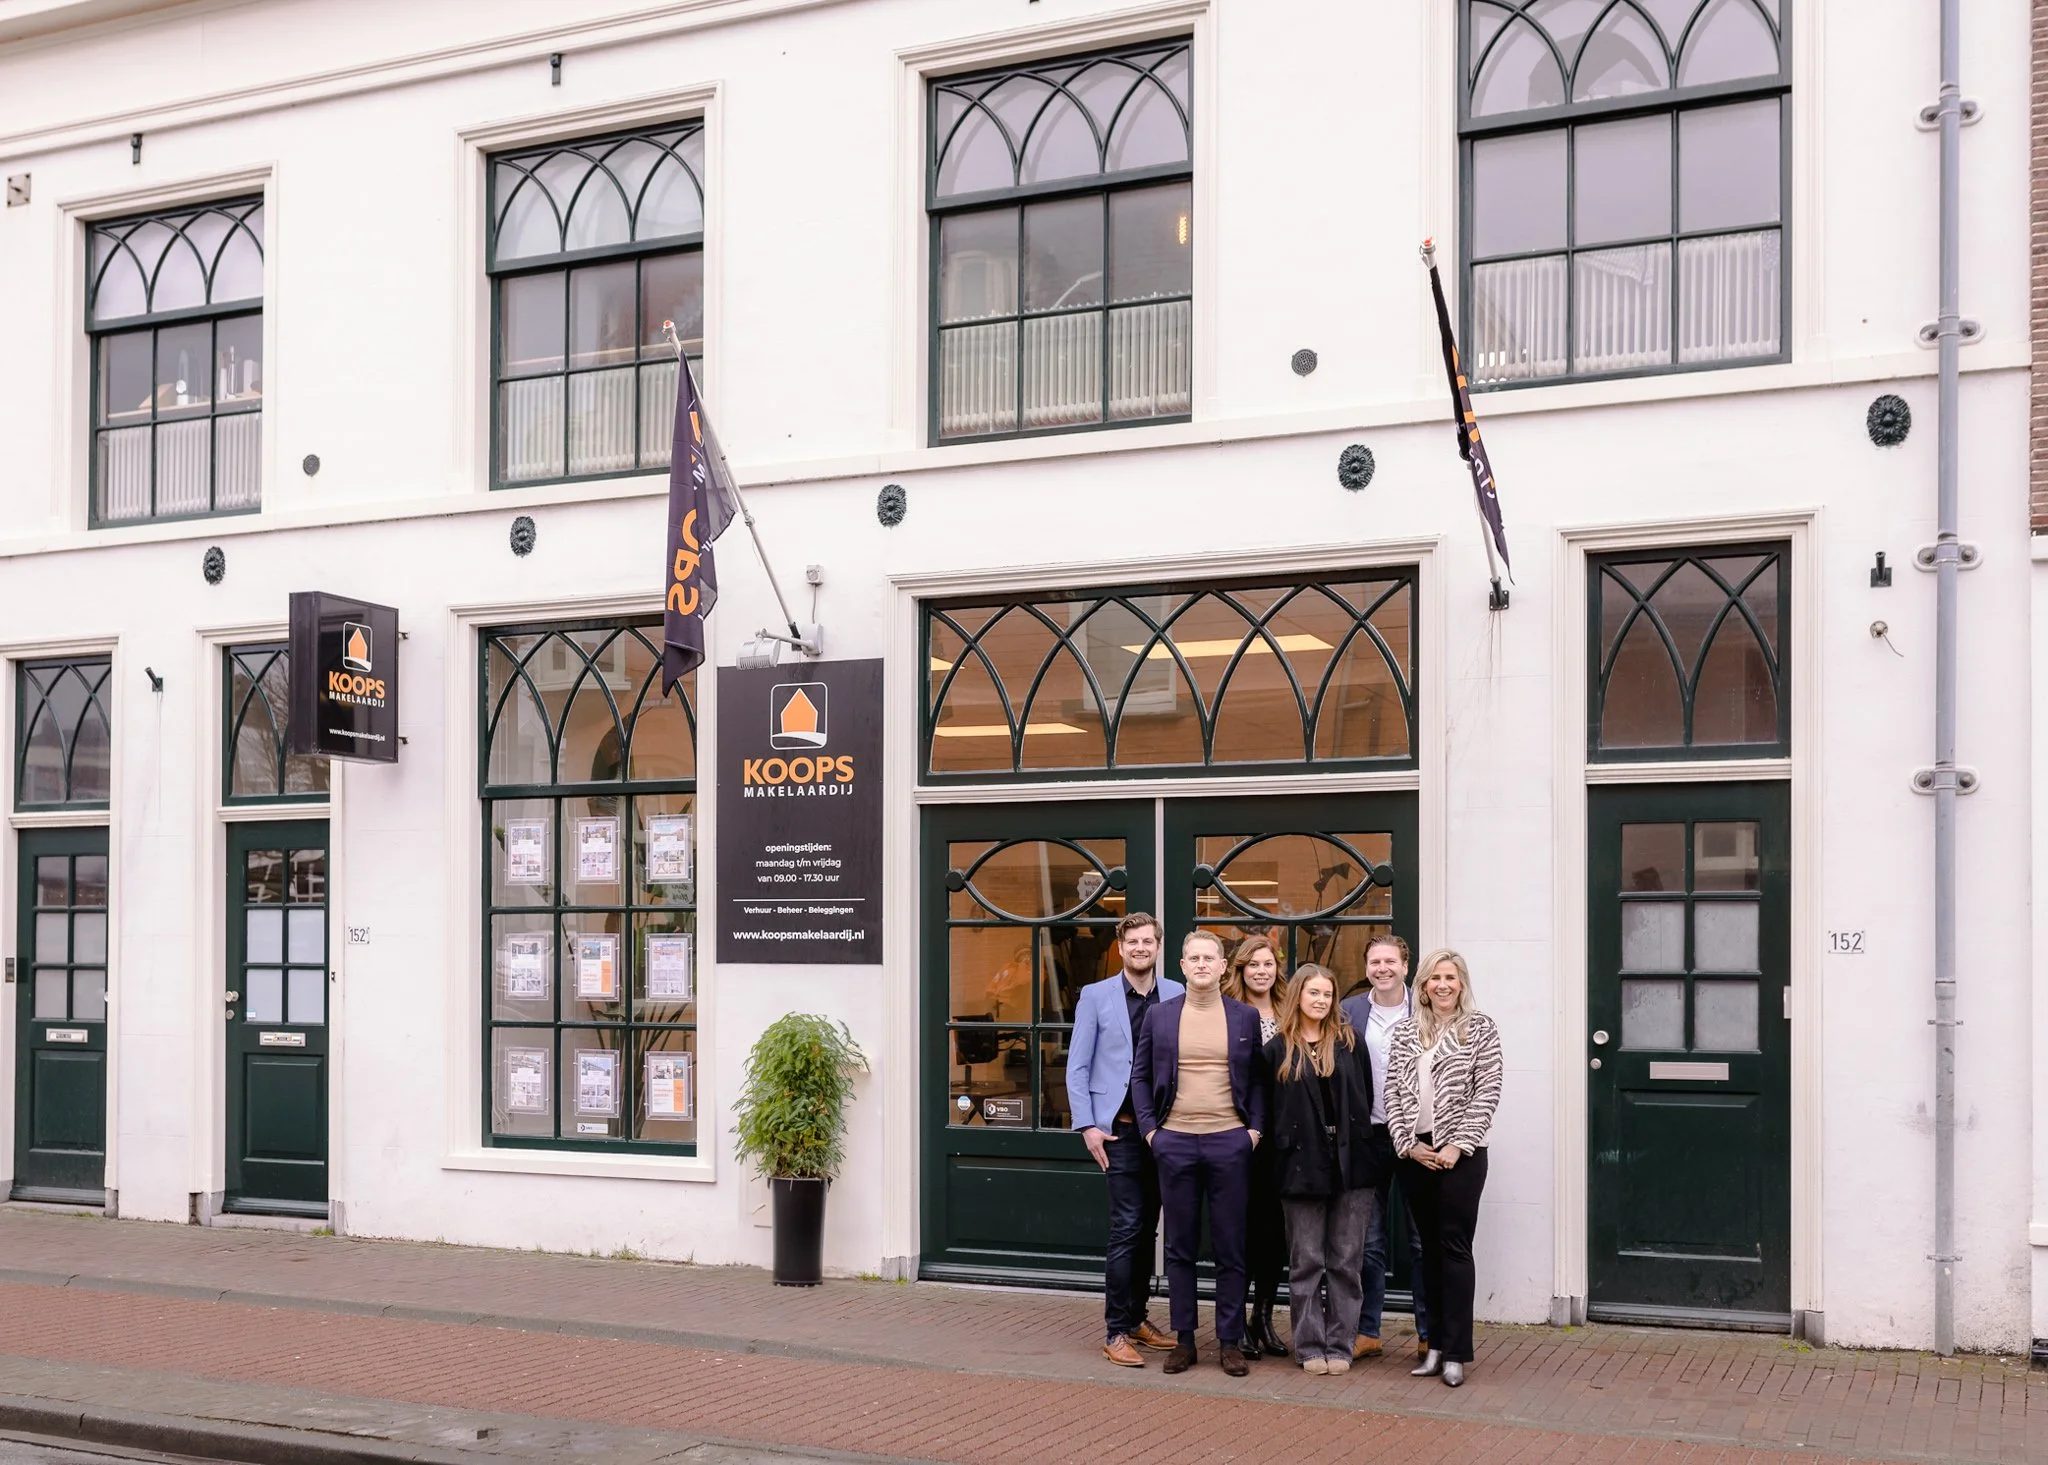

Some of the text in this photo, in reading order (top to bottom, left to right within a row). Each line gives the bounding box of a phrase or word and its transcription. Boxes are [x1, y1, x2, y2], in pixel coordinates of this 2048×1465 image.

[328, 671, 386, 699] KOOPS
[328, 691, 385, 708] MAKELAARDIJ
[328, 728, 386, 742] www.koopsmakelaardij.nl
[743, 755, 855, 785] KOOPS
[743, 784, 853, 798] MAKELAARDIJ
[765, 843, 832, 854] openingstijden:
[755, 858, 842, 868] maandag t/m vrijdag
[757, 874, 773, 883] van
[773, 874, 797, 883] 09.00
[803, 873, 824, 882] 17.30
[824, 874, 840, 882] uur
[743, 906, 773, 914] Verhuur
[777, 906, 803, 914] Beheer
[808, 905, 854, 915] Beleggingen
[349, 928, 366, 942] 152
[733, 928, 865, 942] www.koopsmakelaardij.nl
[1831, 932, 1862, 951] 152
